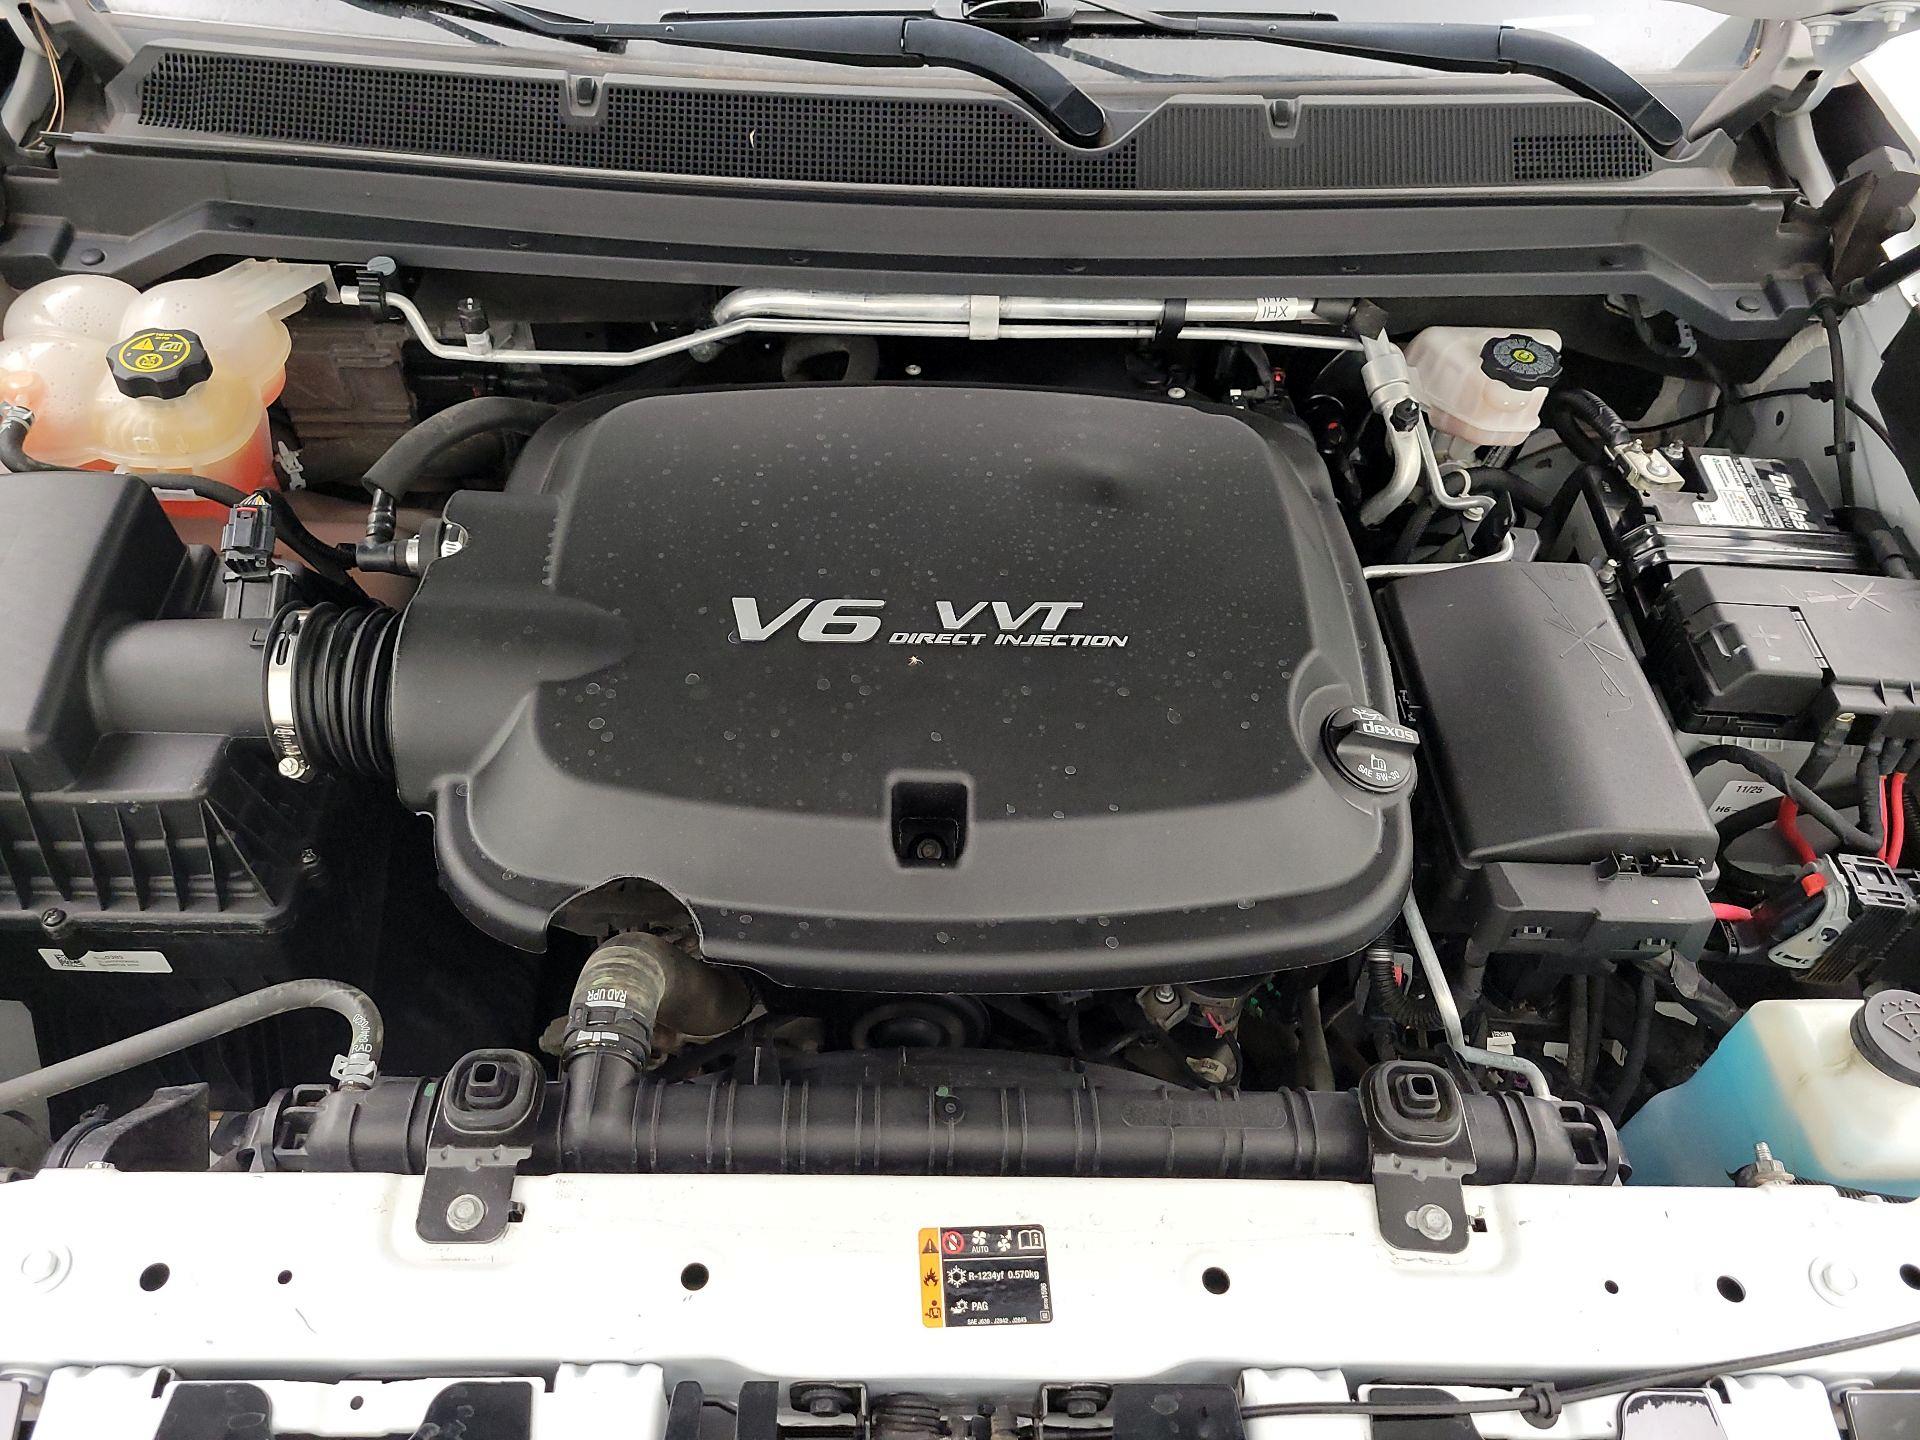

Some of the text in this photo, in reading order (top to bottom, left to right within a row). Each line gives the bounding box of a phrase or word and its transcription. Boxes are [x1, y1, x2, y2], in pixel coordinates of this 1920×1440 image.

[1768, 473, 1810, 530] Duralas
[1770, 494, 1794, 528] PLATINU
[731, 597, 886, 643] V6
[936, 600, 1083, 632] VVT
[888, 631, 1129, 648] DIRECT INJECTION
[1362, 721, 1415, 741] dexos
[1357, 764, 1400, 782] SAE 5W-30
[1736, 785, 1764, 794] 11/25
[587, 988, 627, 1002] RAD UPR
[352, 1044, 372, 1053] RAD
[971, 1245, 989, 1253] AUTO
[968, 1270, 1040, 1282] R-1234yf 0.570kg
[971, 1301, 989, 1311] PAG
